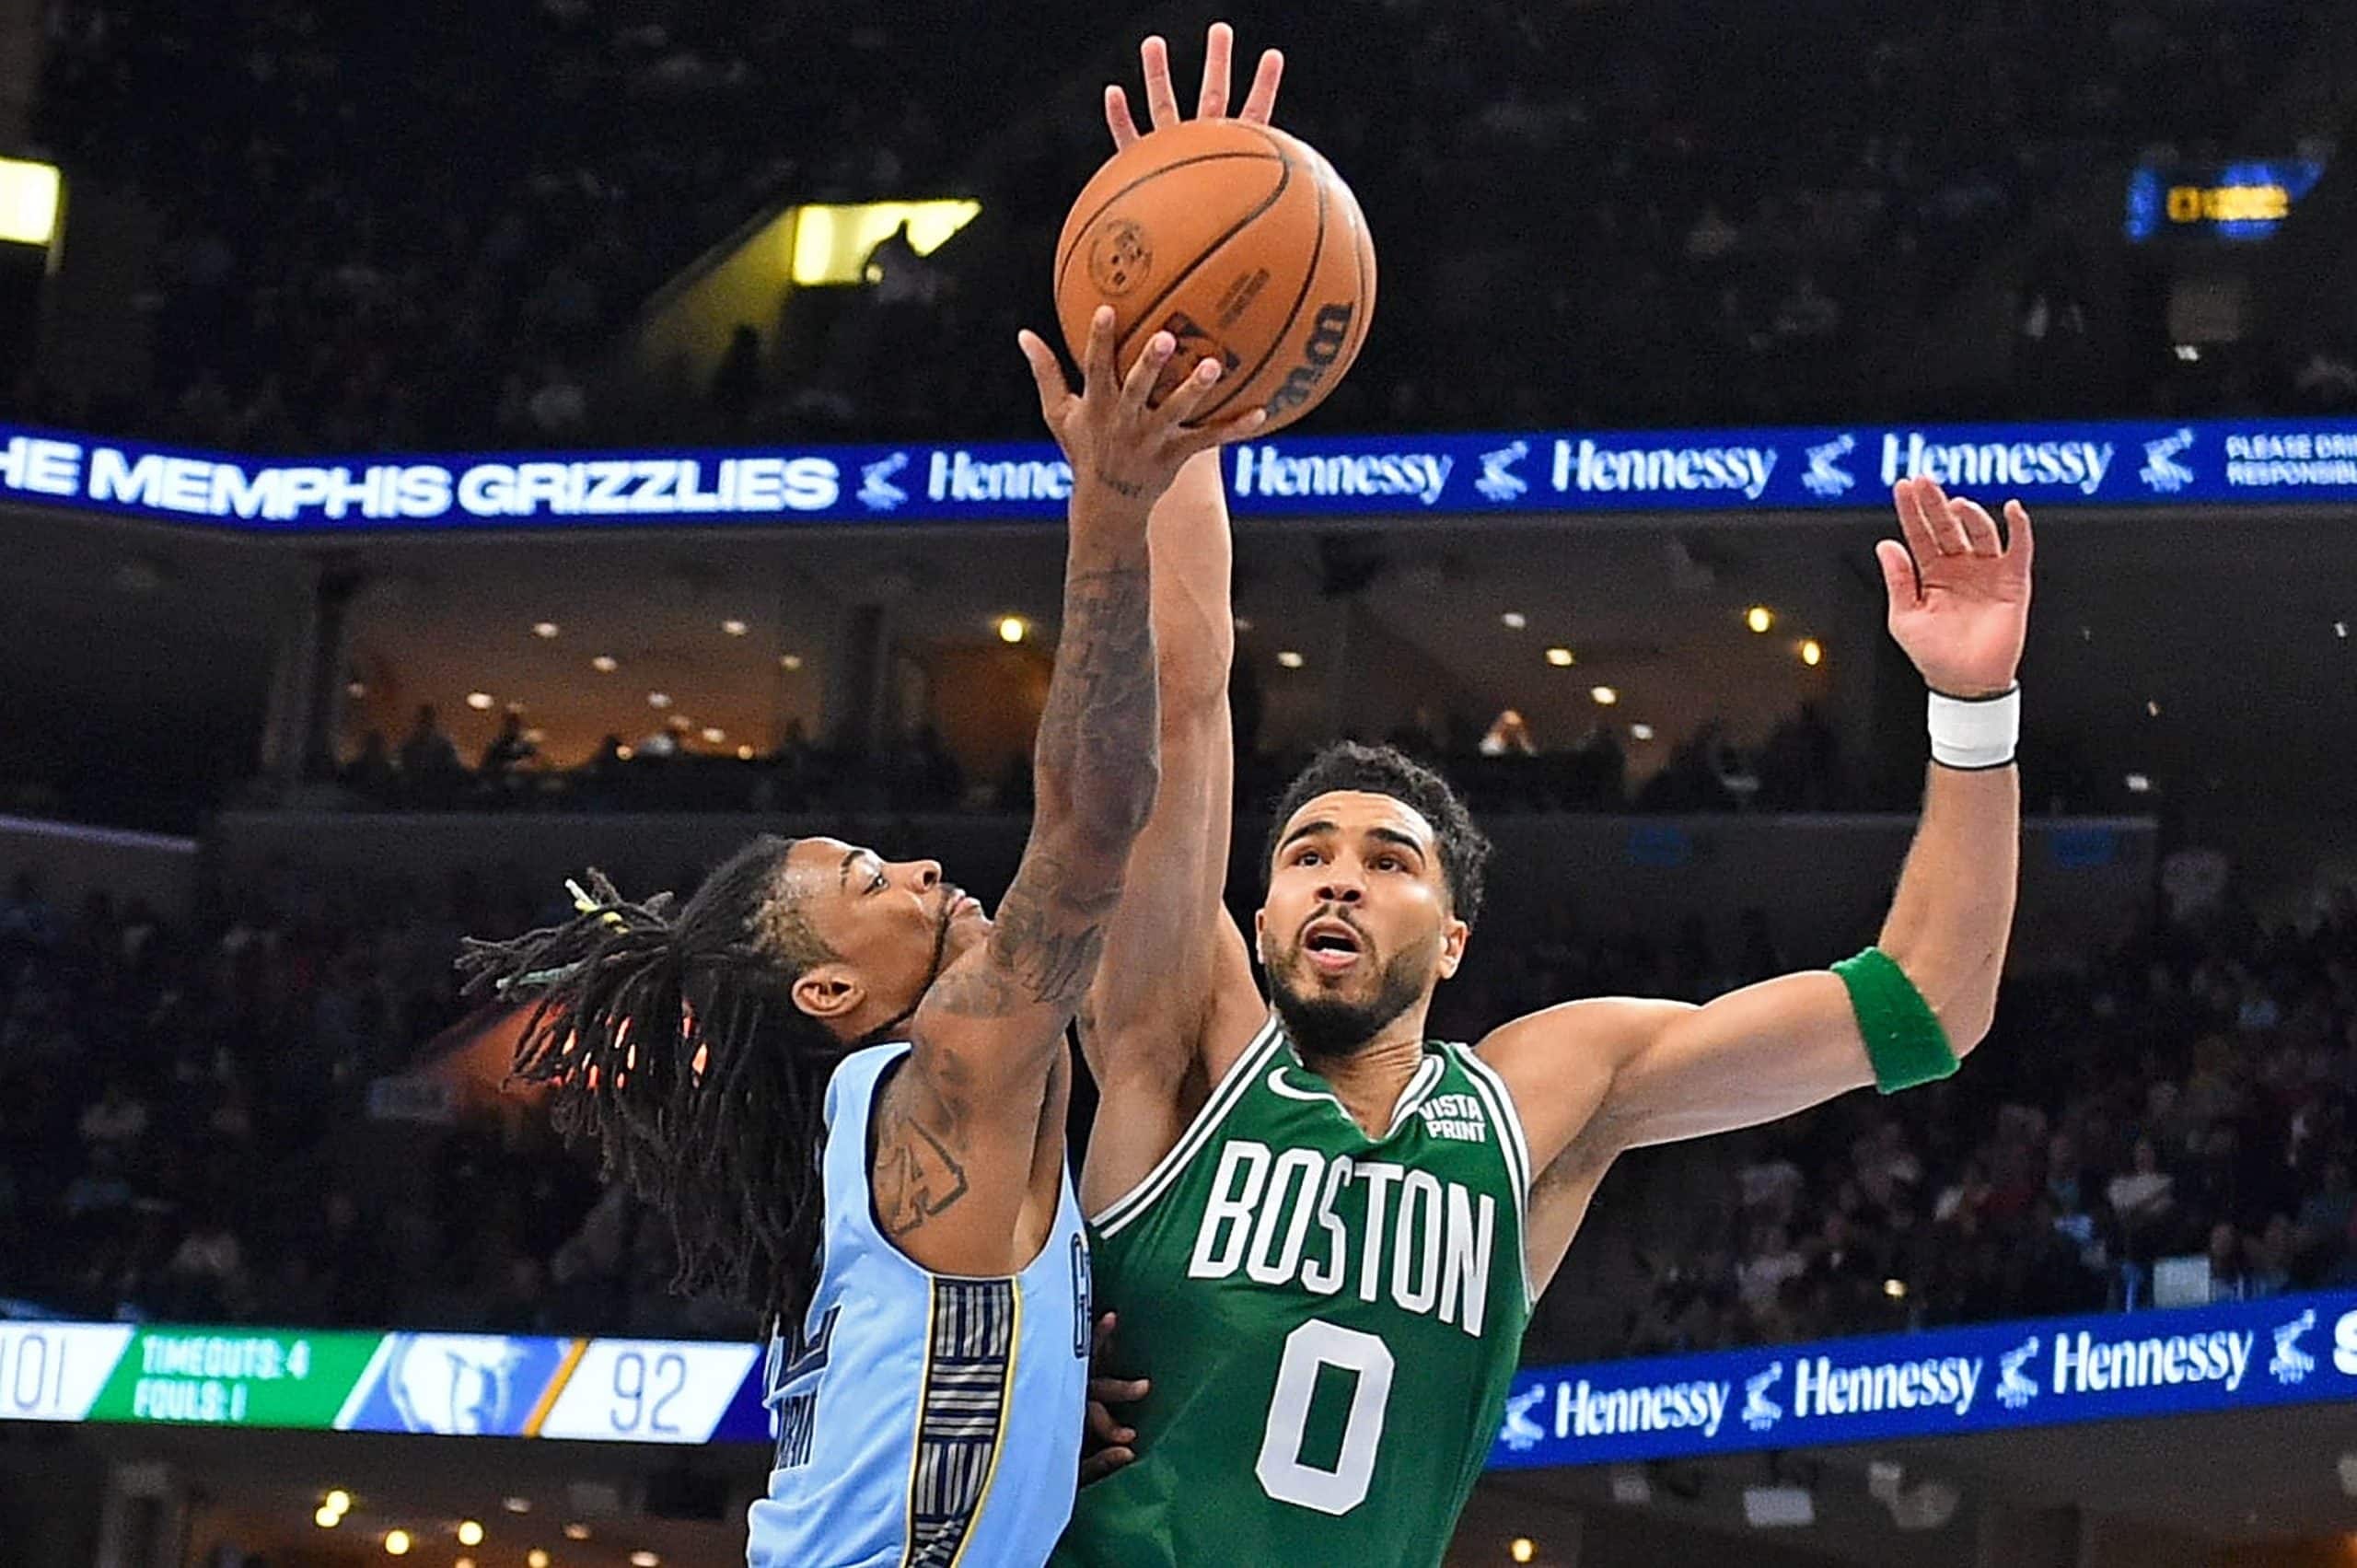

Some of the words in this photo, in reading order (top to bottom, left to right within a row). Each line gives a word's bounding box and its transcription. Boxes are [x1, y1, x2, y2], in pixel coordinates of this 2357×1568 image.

[1235, 446, 1452, 505] Hennessy
[1552, 439, 1777, 499] Hennessy
[1881, 433, 2114, 495] Hennessy
[2226, 435, 2312, 459] PLEASE
[89, 447, 452, 519] MEMPHIS
[459, 458, 839, 516] GRIZZLIES
[1419, 1094, 1484, 1121] VISTA
[1426, 1120, 1486, 1143] PRINT
[1187, 1139, 1495, 1338] BOSTON
[1794, 1357, 1982, 1416] Hennessy
[2053, 1330, 2254, 1394] Hennessy
[134, 1378, 228, 1421] FOULS:
[610, 1351, 687, 1433] 92
[1254, 1318, 1396, 1516] 0
[1554, 1380, 1730, 1436] Hennessy
